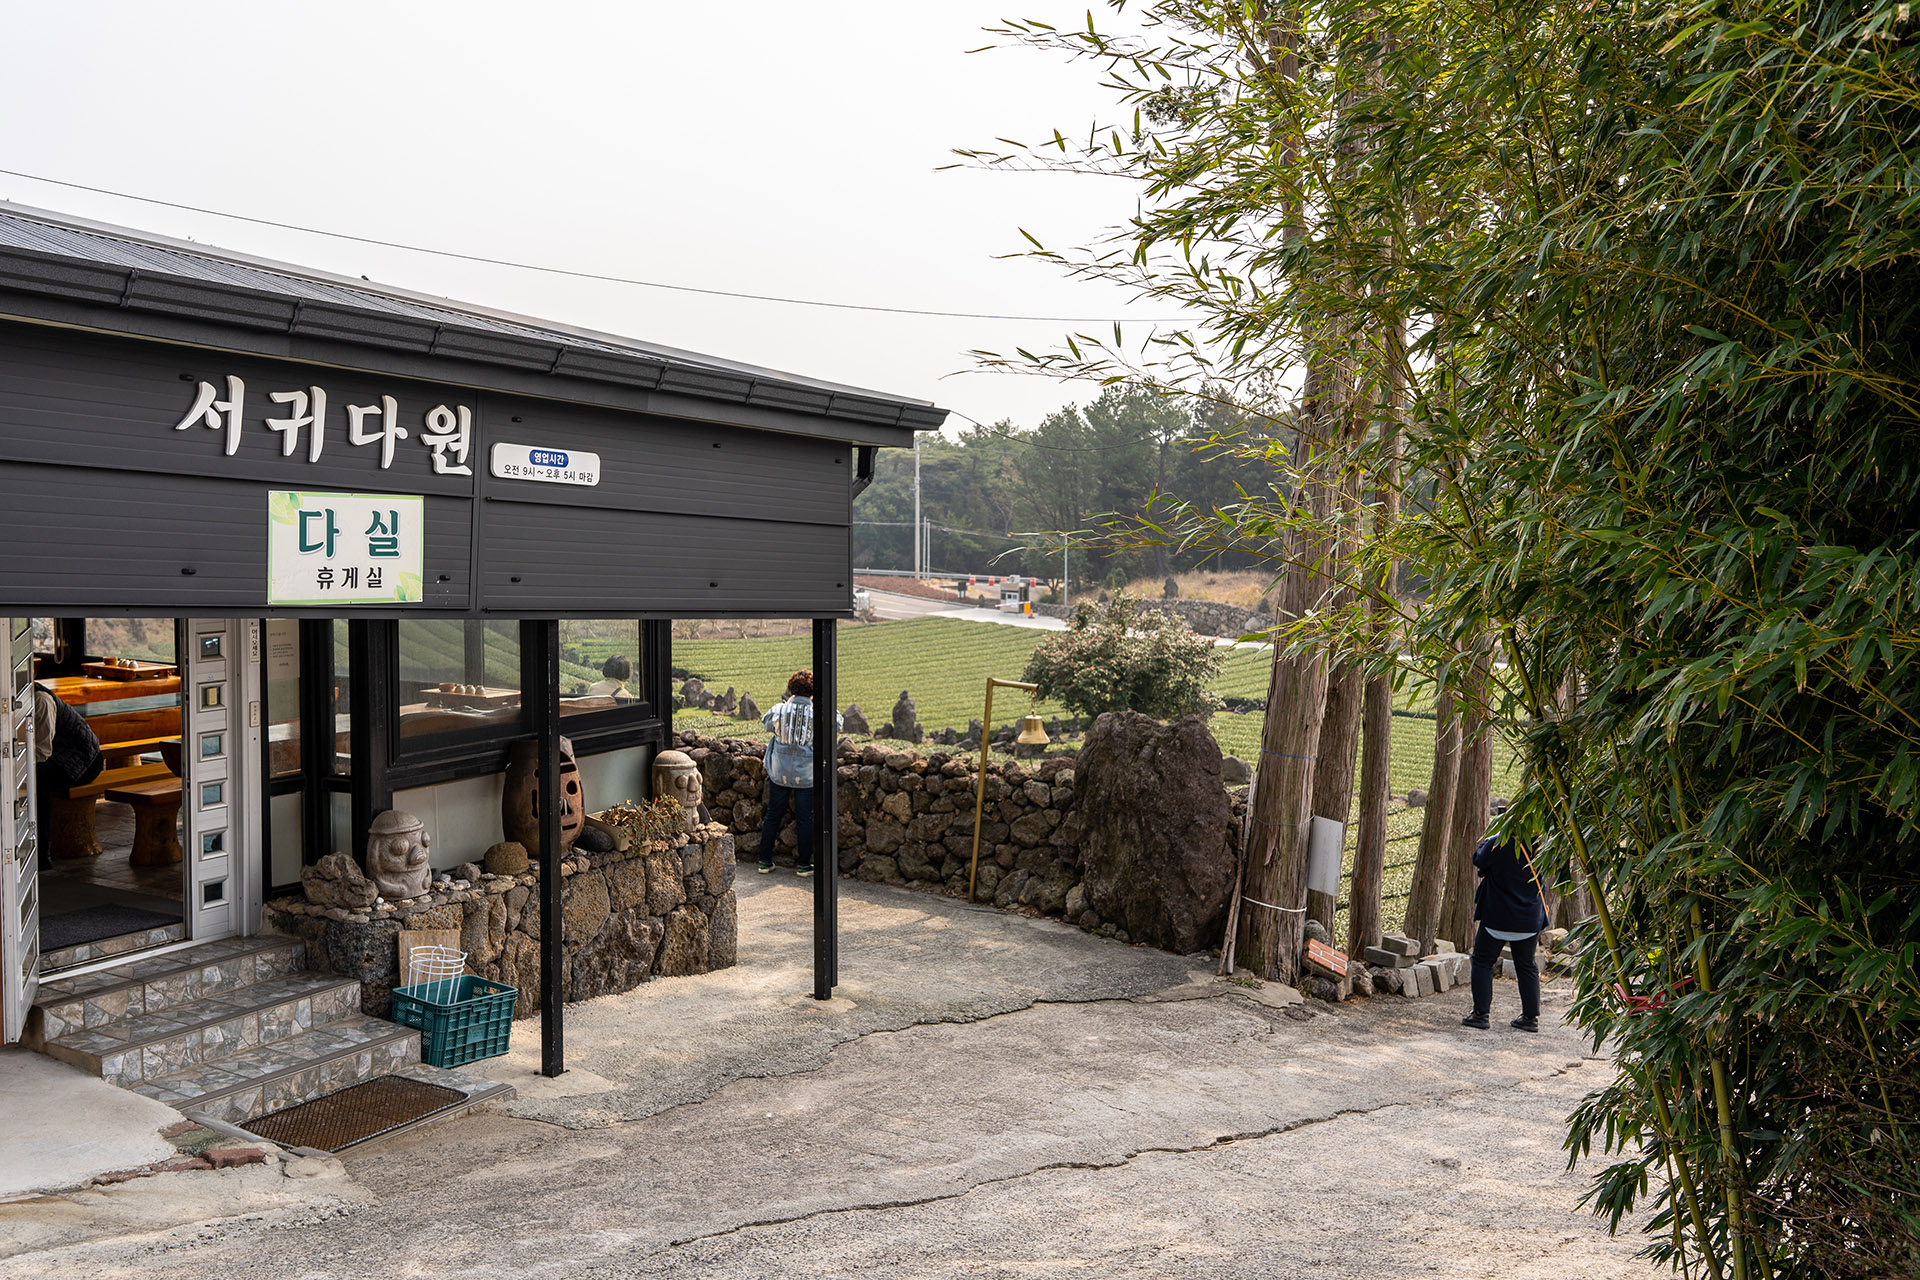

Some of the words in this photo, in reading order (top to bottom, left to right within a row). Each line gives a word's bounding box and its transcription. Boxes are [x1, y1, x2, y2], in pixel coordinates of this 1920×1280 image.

[176, 374, 473, 477] 서귀다원
[534, 452, 564, 465] 영업시간
[504, 465, 519, 475] 오전
[563, 471, 575, 480] 5시
[579, 472, 593, 482] 마감
[316, 566, 383, 590] 휴게실
